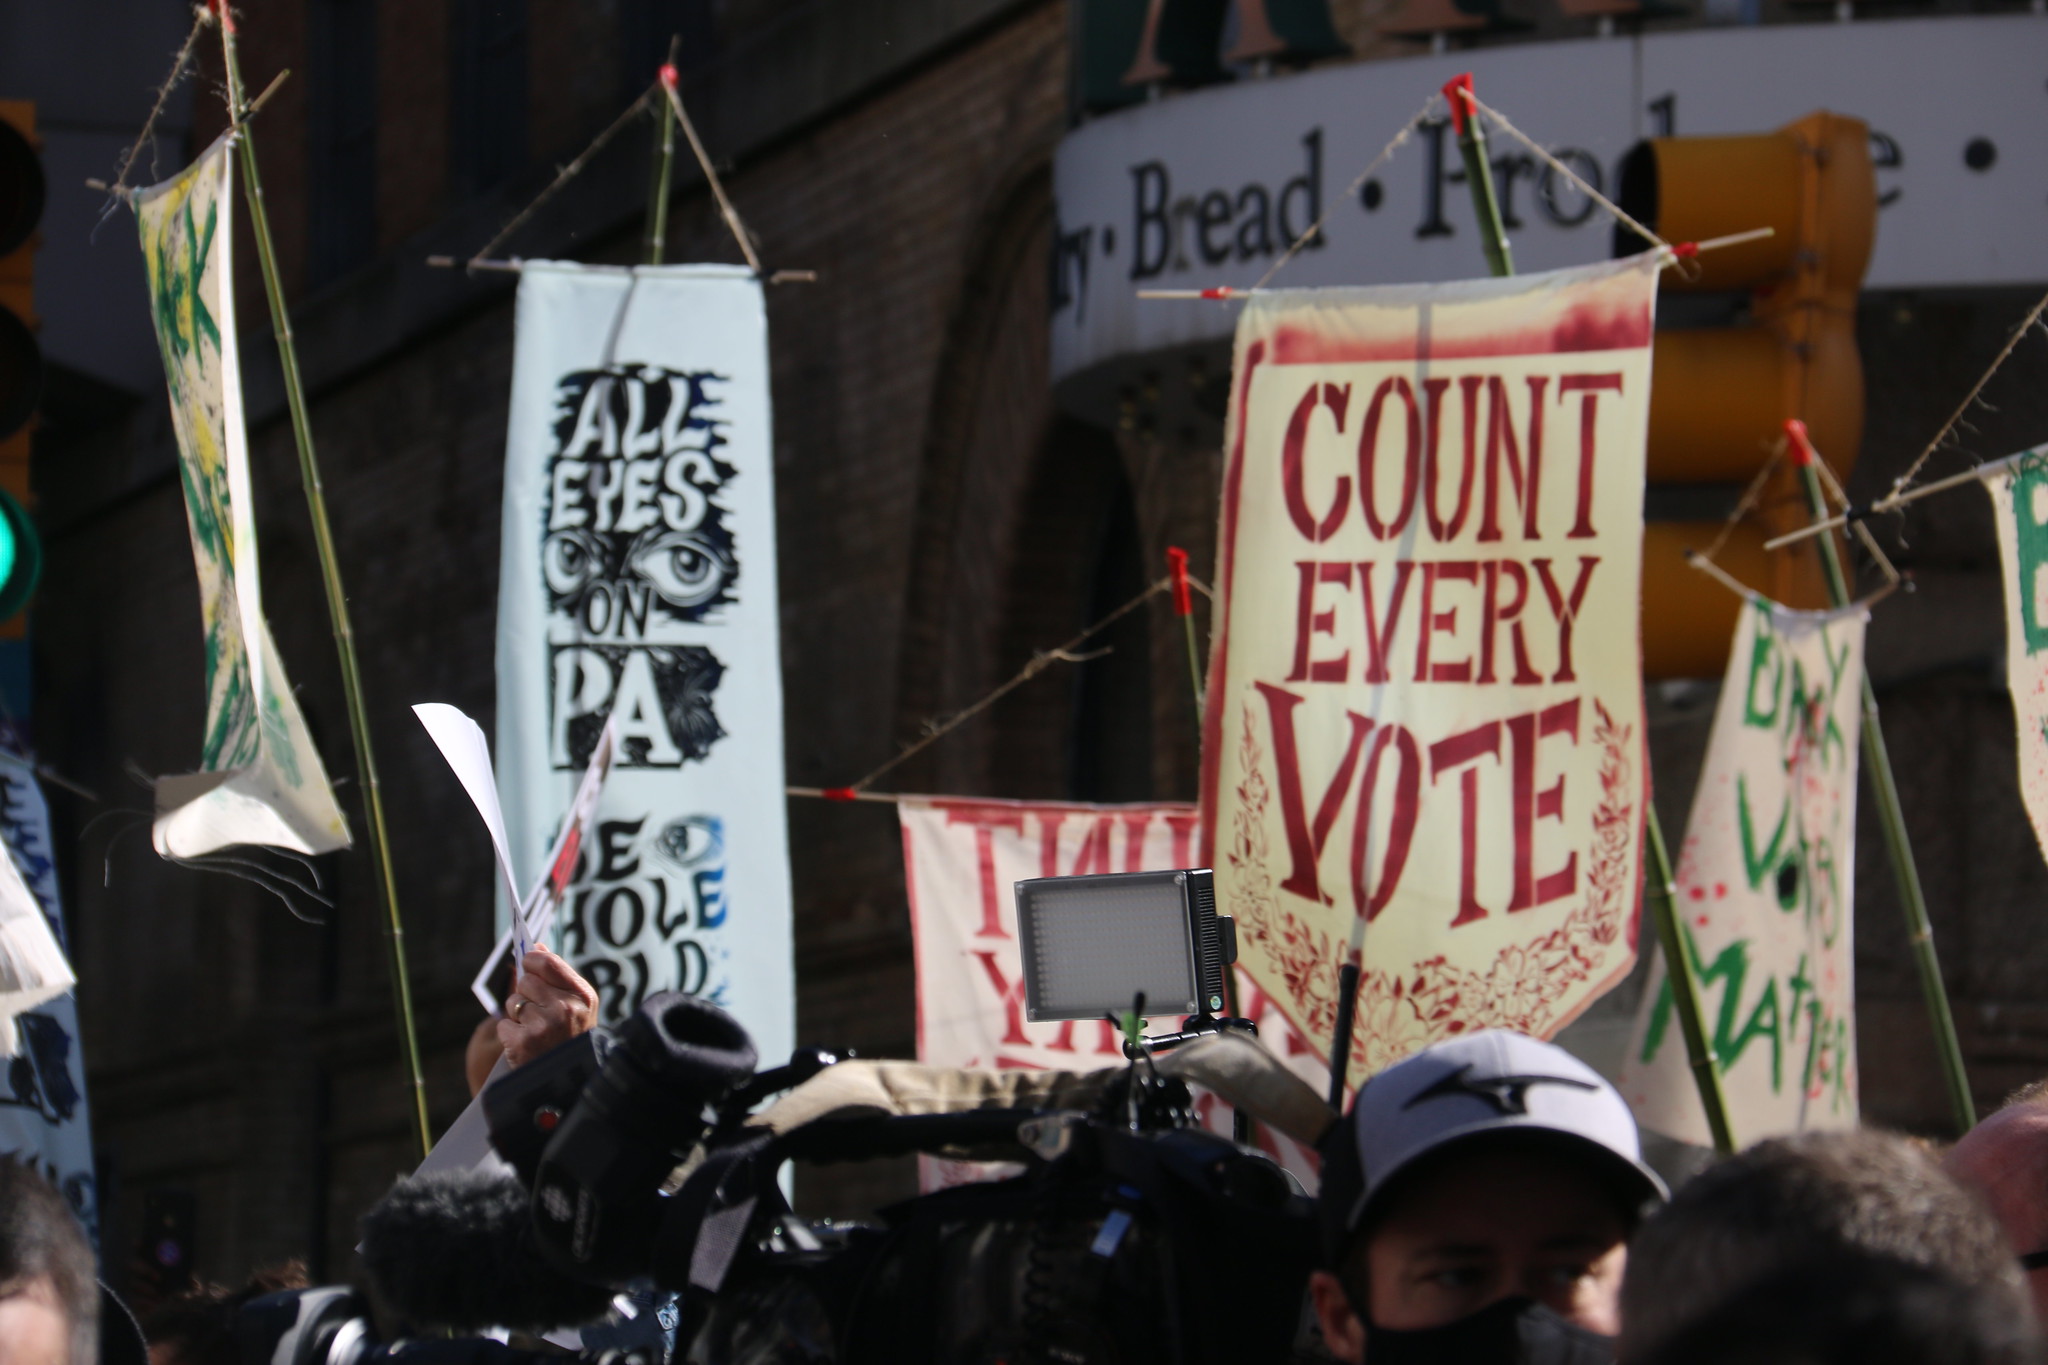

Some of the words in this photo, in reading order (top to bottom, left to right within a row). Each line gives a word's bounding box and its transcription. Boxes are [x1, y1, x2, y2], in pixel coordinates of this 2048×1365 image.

[1128, 126, 1326, 281] Bread
[563, 373, 711, 460] ALL
[1281, 371, 1624, 544] COUNT
[549, 446, 721, 532] EYES
[580, 579, 654, 639] ON
[1284, 556, 1602, 686] EVERY
[553, 648, 683, 767] PA
[1254, 680, 1582, 929] VOTE
